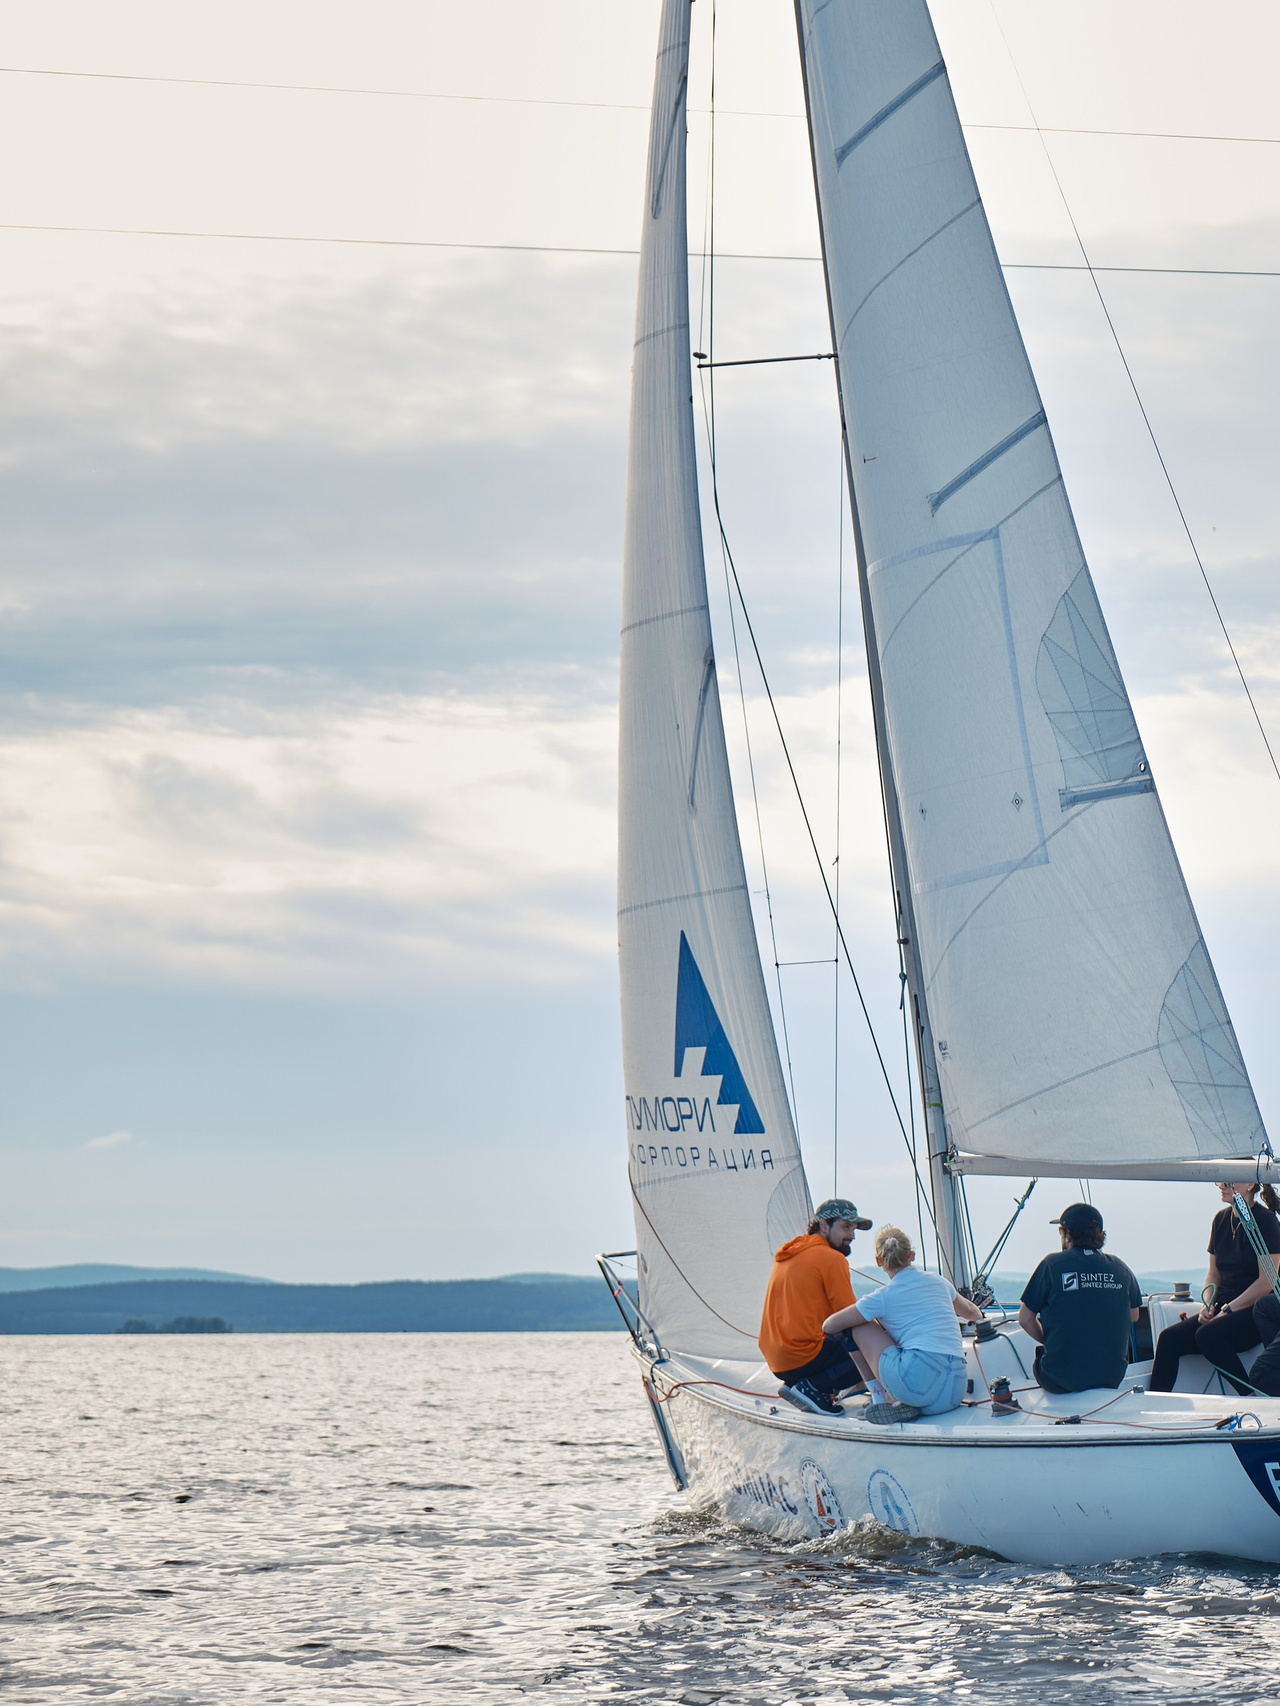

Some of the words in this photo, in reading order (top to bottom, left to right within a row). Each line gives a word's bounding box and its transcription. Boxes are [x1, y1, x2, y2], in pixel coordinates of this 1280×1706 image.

[626, 1095, 716, 1133] ПУМОРИ
[1080, 1273, 1115, 1282] SINTEZ
[1081, 1281, 1103, 1289] SINTEZ
[1103, 1282, 1123, 1290] GROUP
